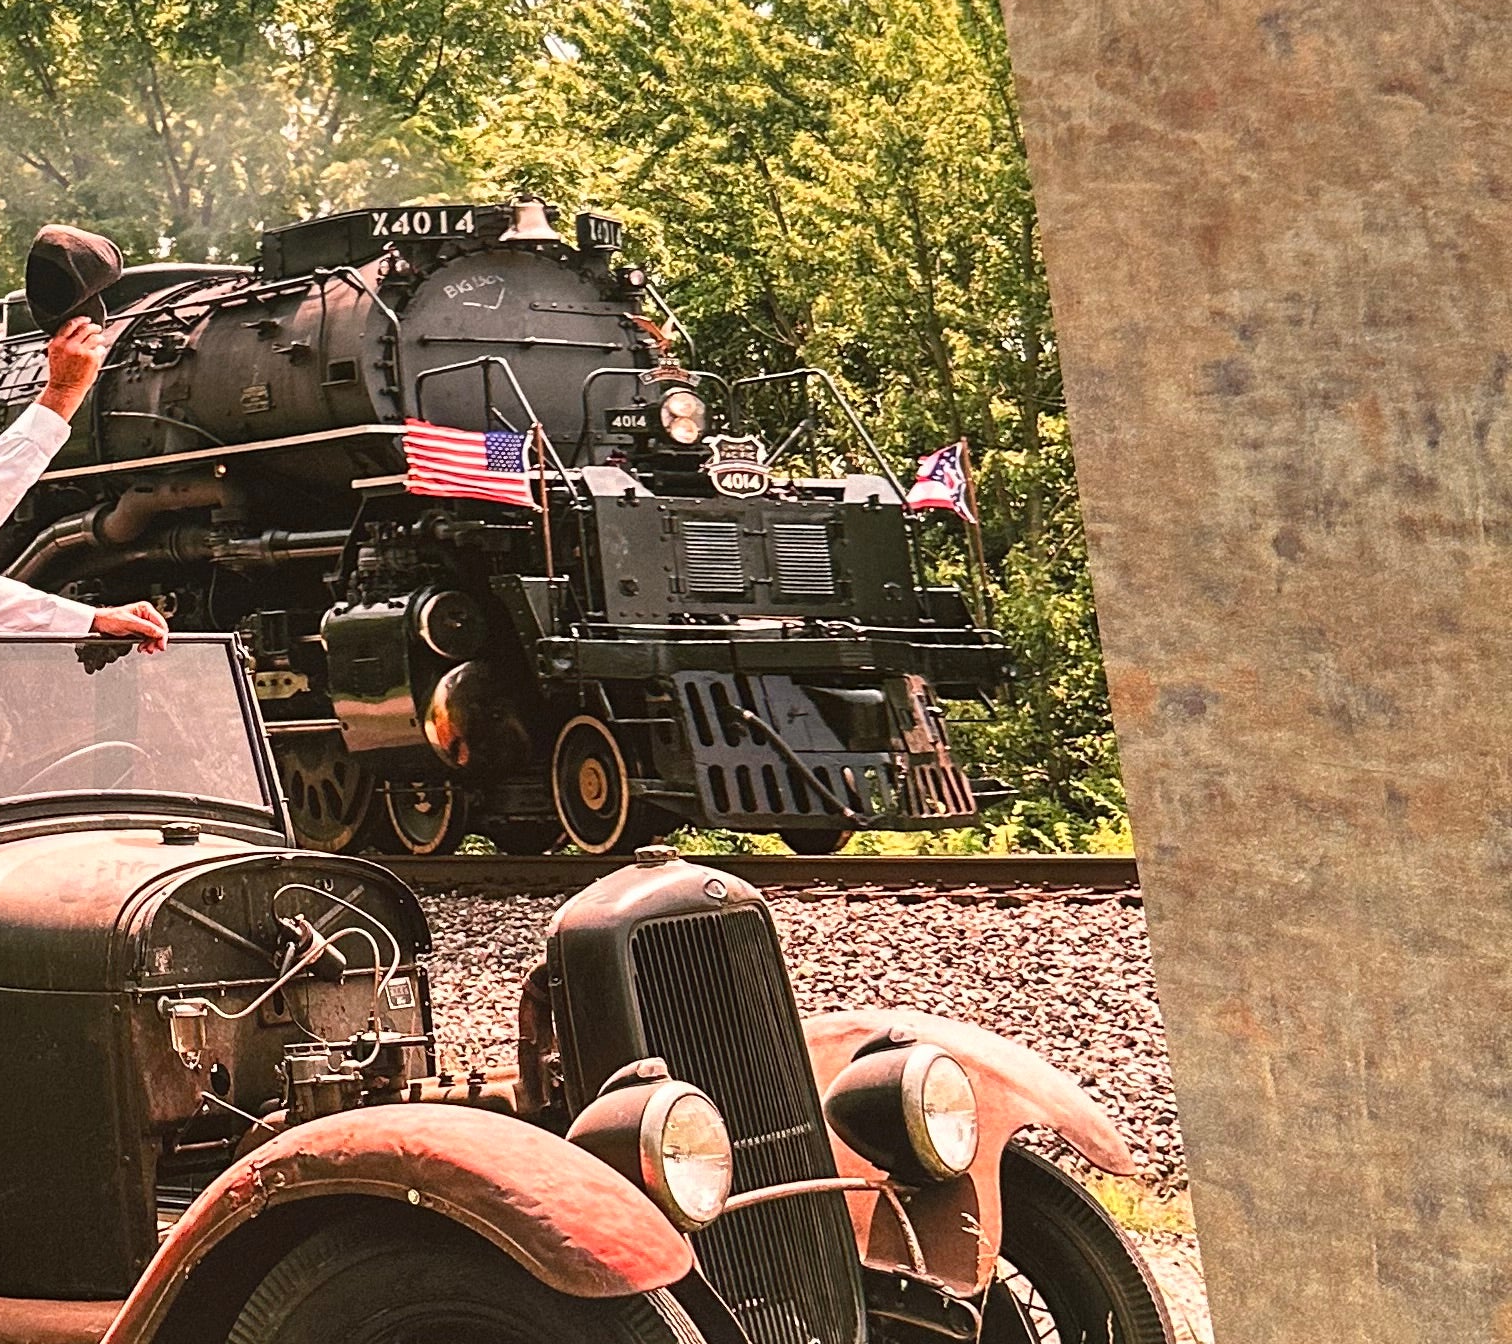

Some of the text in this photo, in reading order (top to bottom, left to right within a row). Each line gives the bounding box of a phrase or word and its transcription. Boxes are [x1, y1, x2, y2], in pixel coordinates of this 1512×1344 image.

[371, 210, 475, 236] X4014
[443, 279, 474, 299] BIG
[611, 415, 647, 427] 4014
[721, 472, 761, 490] 4014
